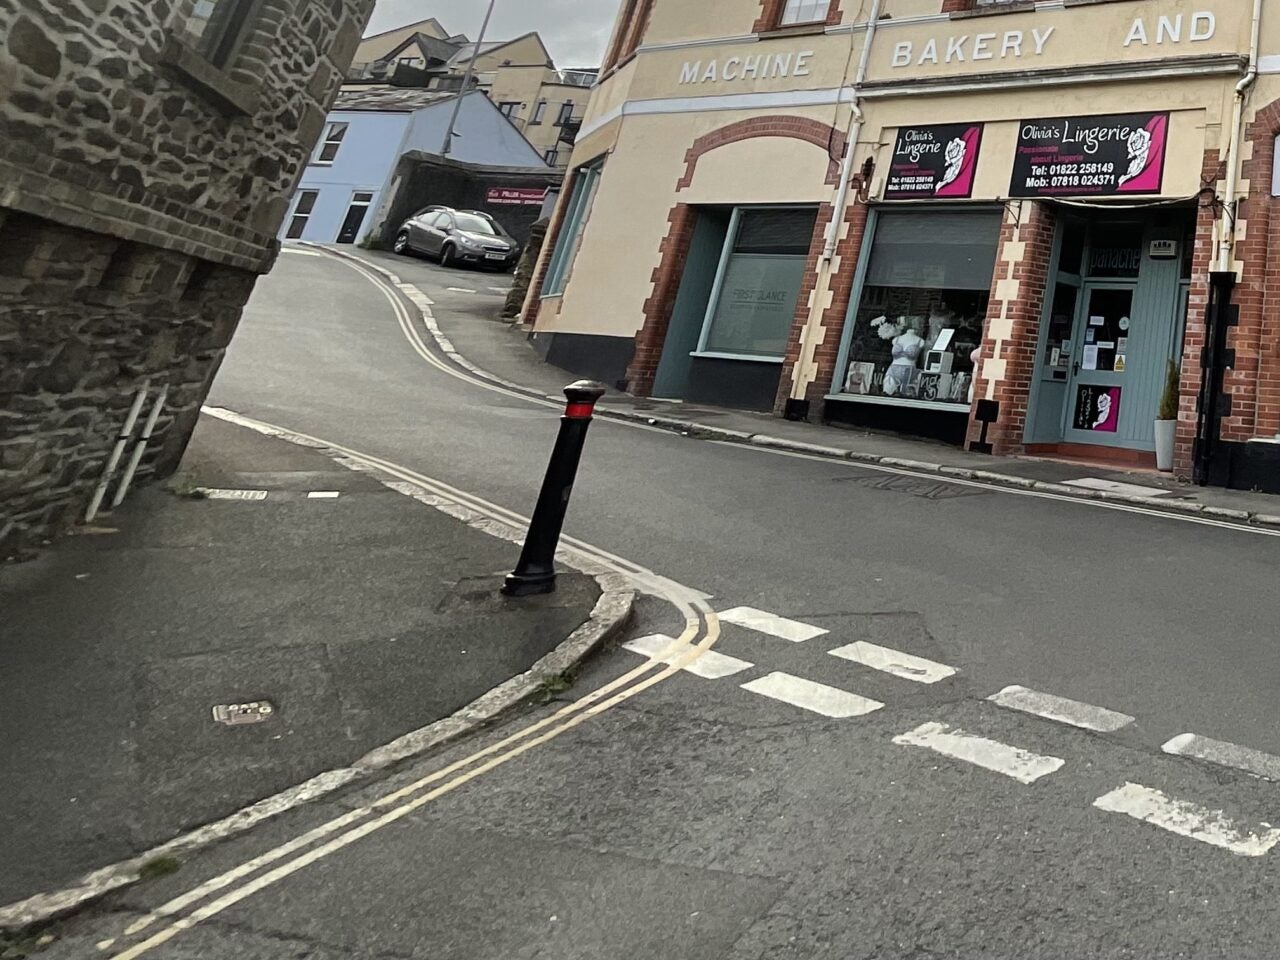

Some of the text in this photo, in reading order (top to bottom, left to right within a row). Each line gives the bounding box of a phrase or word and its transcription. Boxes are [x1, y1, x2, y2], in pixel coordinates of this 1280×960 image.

[679, 50, 815, 85] MACHINE
[891, 26, 1056, 68] BAKERY
[1123, 10, 1217, 47] AND
[905, 129, 934, 142] Olivia's
[1021, 120, 1130, 154] Olivia's Lingerie
[896, 138, 941, 163] Lingerie
[1031, 162, 1114, 176] Tel: 01822 258149
[1025, 174, 1115, 188] Mob: 07818 024371
